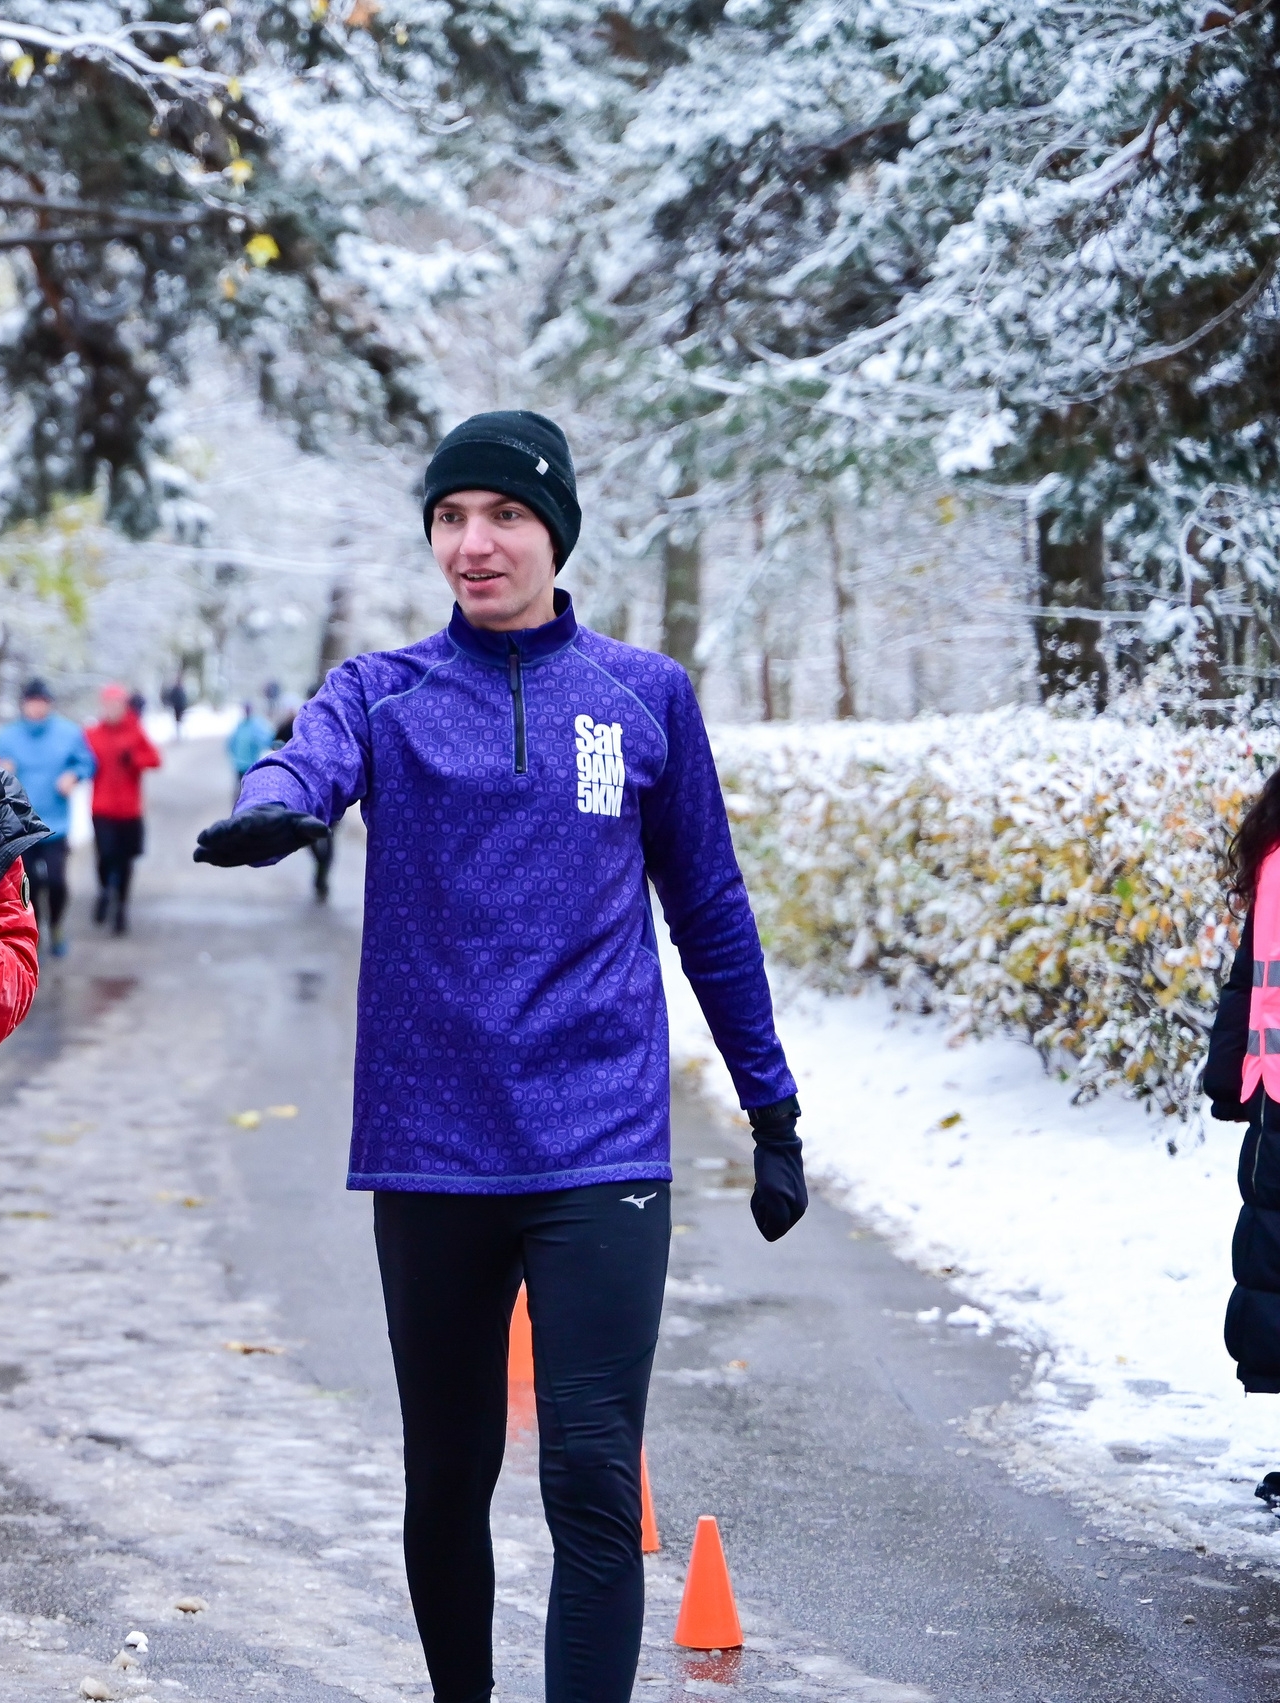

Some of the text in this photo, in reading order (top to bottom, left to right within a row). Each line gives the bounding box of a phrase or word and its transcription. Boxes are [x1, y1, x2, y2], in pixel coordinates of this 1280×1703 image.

[575, 714, 623, 759] Sat
[576, 752, 625, 788] 9AM
[577, 781, 624, 818] 5KM
